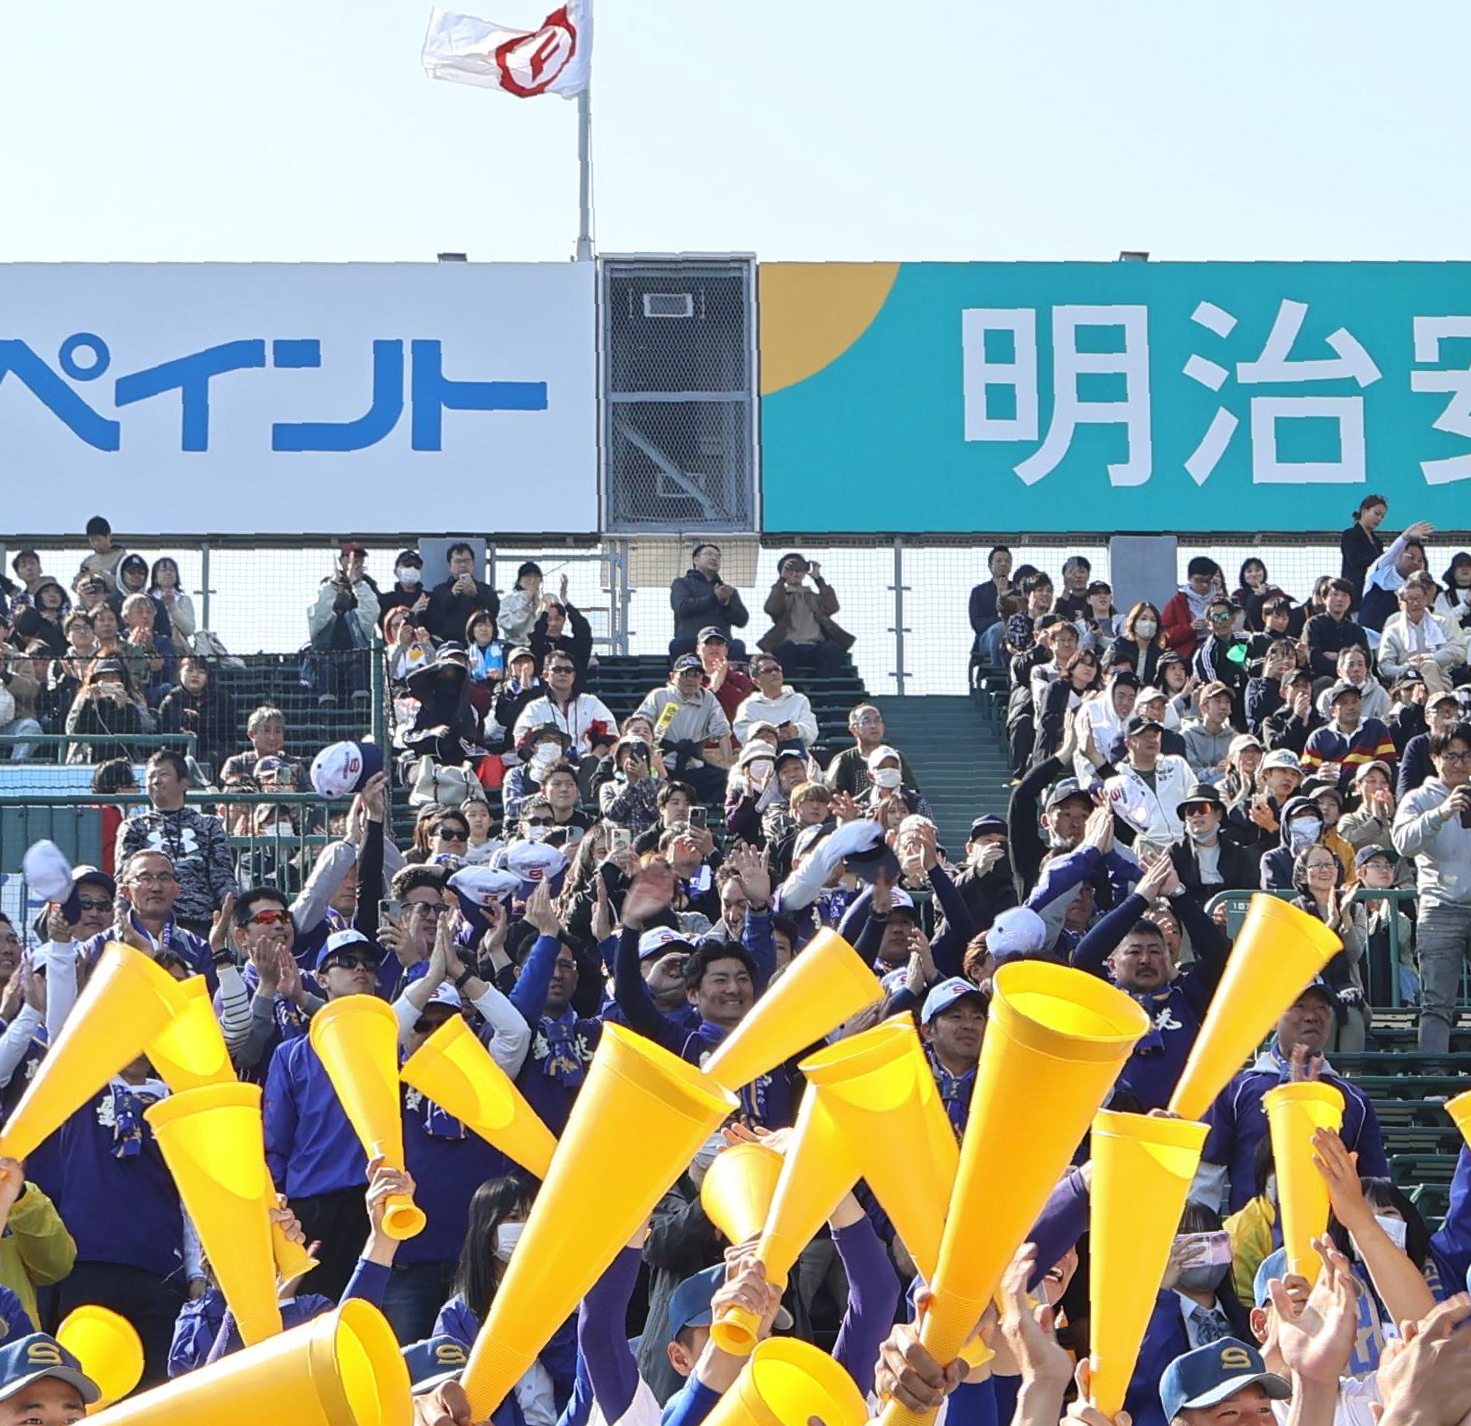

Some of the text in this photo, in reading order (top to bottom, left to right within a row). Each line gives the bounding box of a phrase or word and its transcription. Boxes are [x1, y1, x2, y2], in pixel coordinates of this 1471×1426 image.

[27, 1341, 64, 1366] S
[436, 1343, 468, 1366] S
[1220, 1347, 1252, 1371] S
